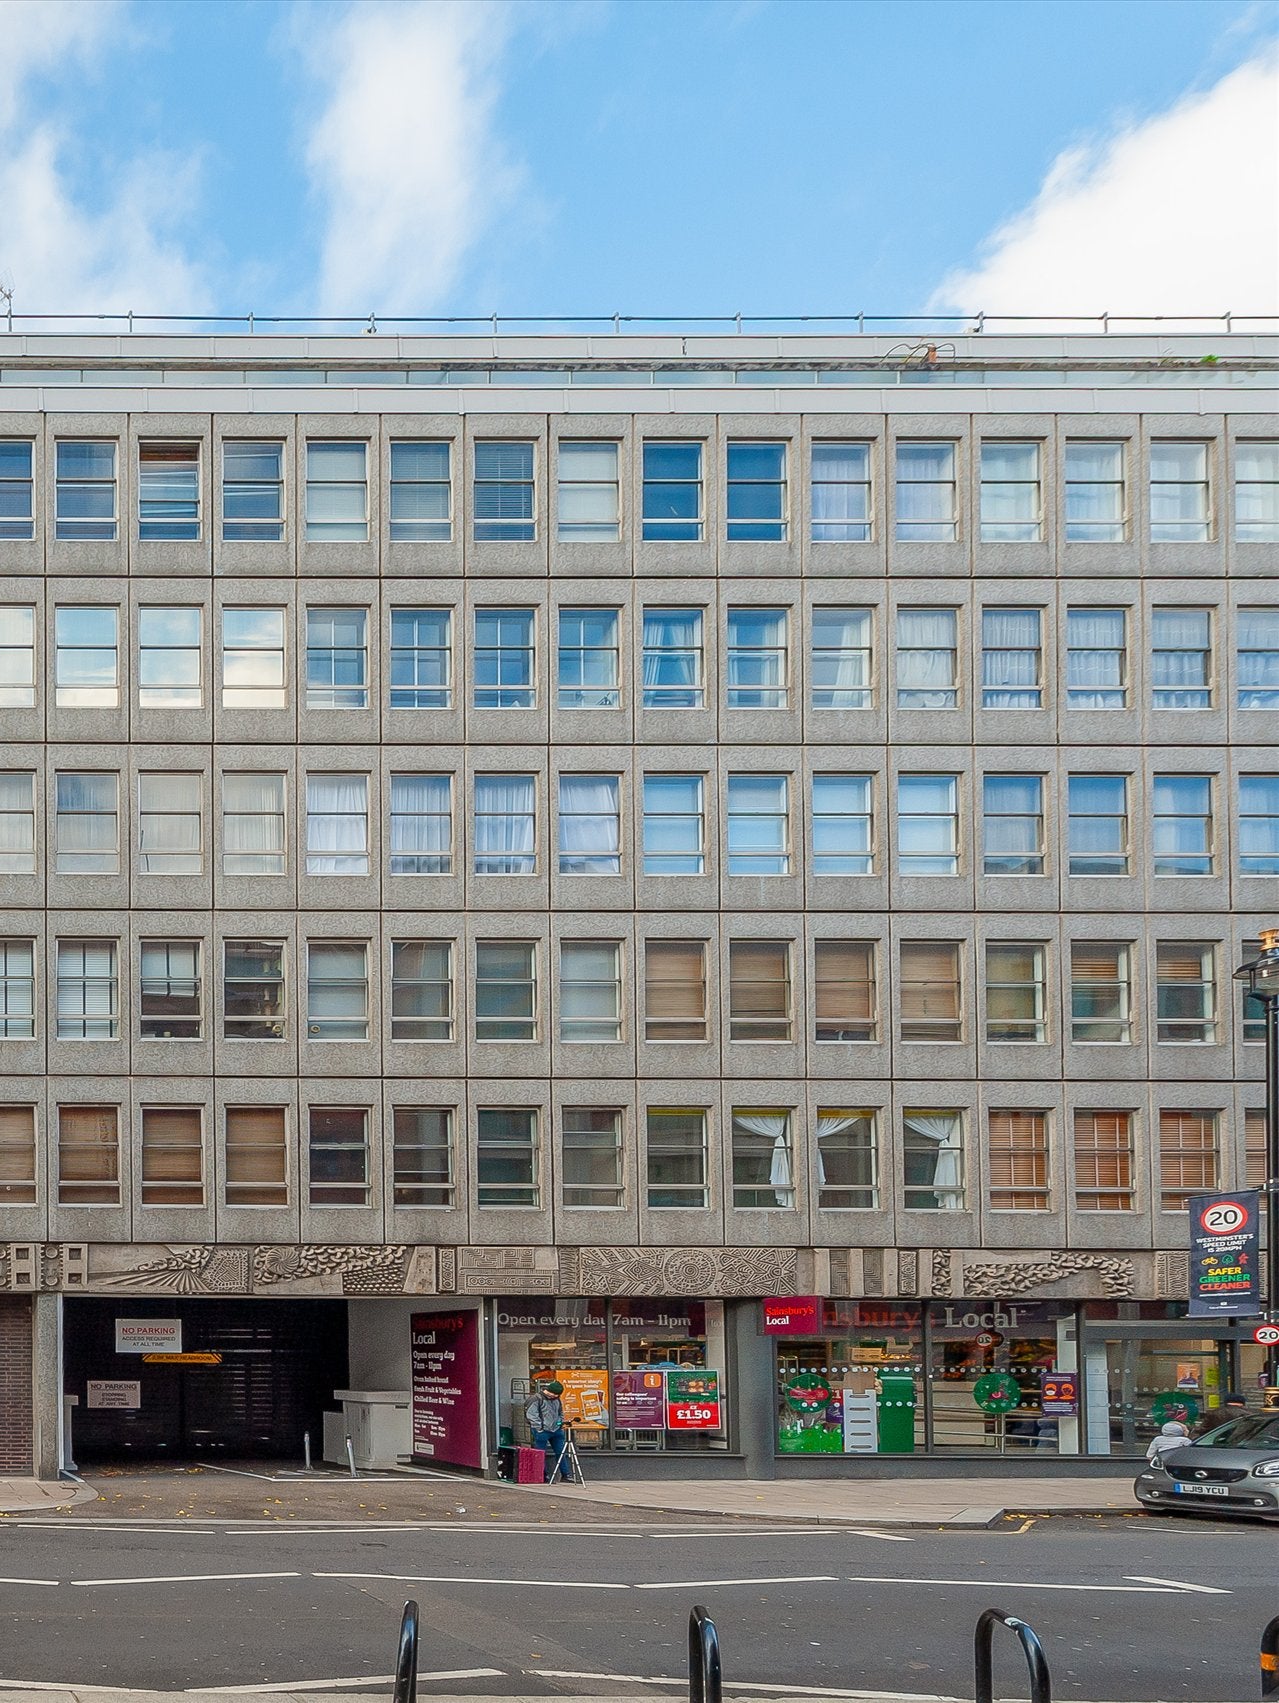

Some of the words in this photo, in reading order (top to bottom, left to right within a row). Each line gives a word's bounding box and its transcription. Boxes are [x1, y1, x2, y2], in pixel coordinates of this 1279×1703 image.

[1210, 1210, 1238, 1226] 20
[1208, 1267, 1242, 1276] SAFER
[1199, 1274, 1251, 1284] GREENER
[1199, 1281, 1251, 1291] CLEANER
[766, 1305, 815, 1316] Sainsbury's
[498, 1312, 537, 1328] Open
[540, 1316, 580, 1328] every
[612, 1313, 644, 1326] 7am
[657, 1314, 692, 1329] 11pm
[766, 1315, 790, 1325] Local
[944, 1307, 1019, 1328] Local
[412, 1331, 436, 1344] Local
[1258, 1331, 1279, 1339] 20
[413, 1350, 427, 1360] Open
[428, 1352, 443, 1360] every
[444, 1350, 455, 1361] day
[413, 1361, 425, 1369] 7am
[676, 1409, 711, 1420] £1.50
